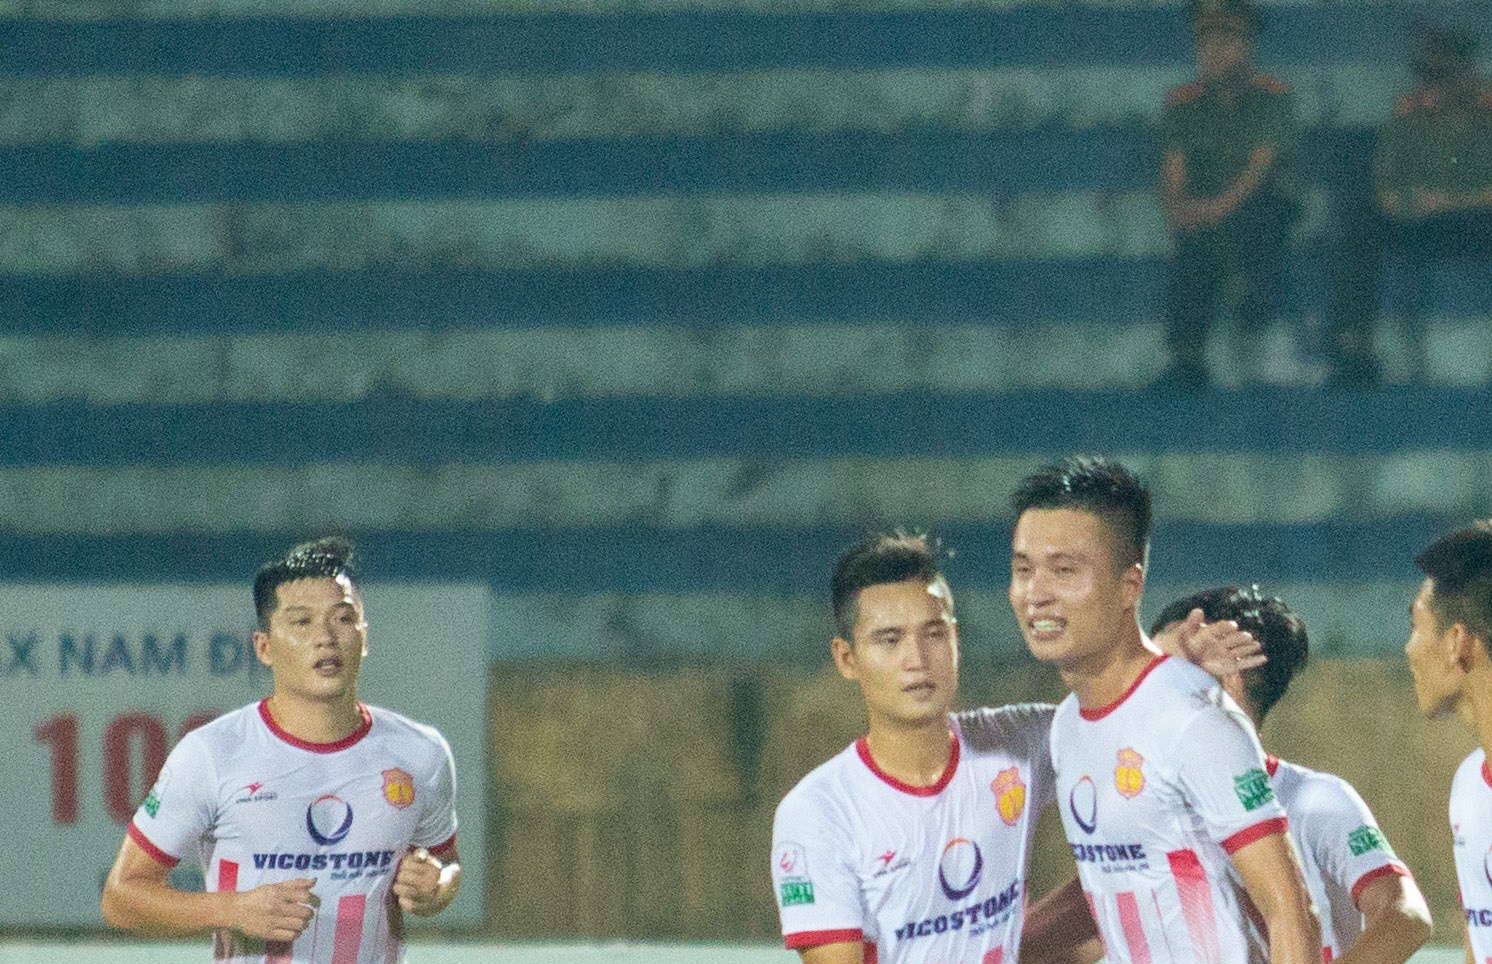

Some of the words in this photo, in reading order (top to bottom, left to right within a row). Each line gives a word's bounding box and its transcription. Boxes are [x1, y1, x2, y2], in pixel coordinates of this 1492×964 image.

[59, 633, 187, 676] NAM
[35, 711, 222, 825] 10
[894, 878, 1020, 941] VICOSTONE
